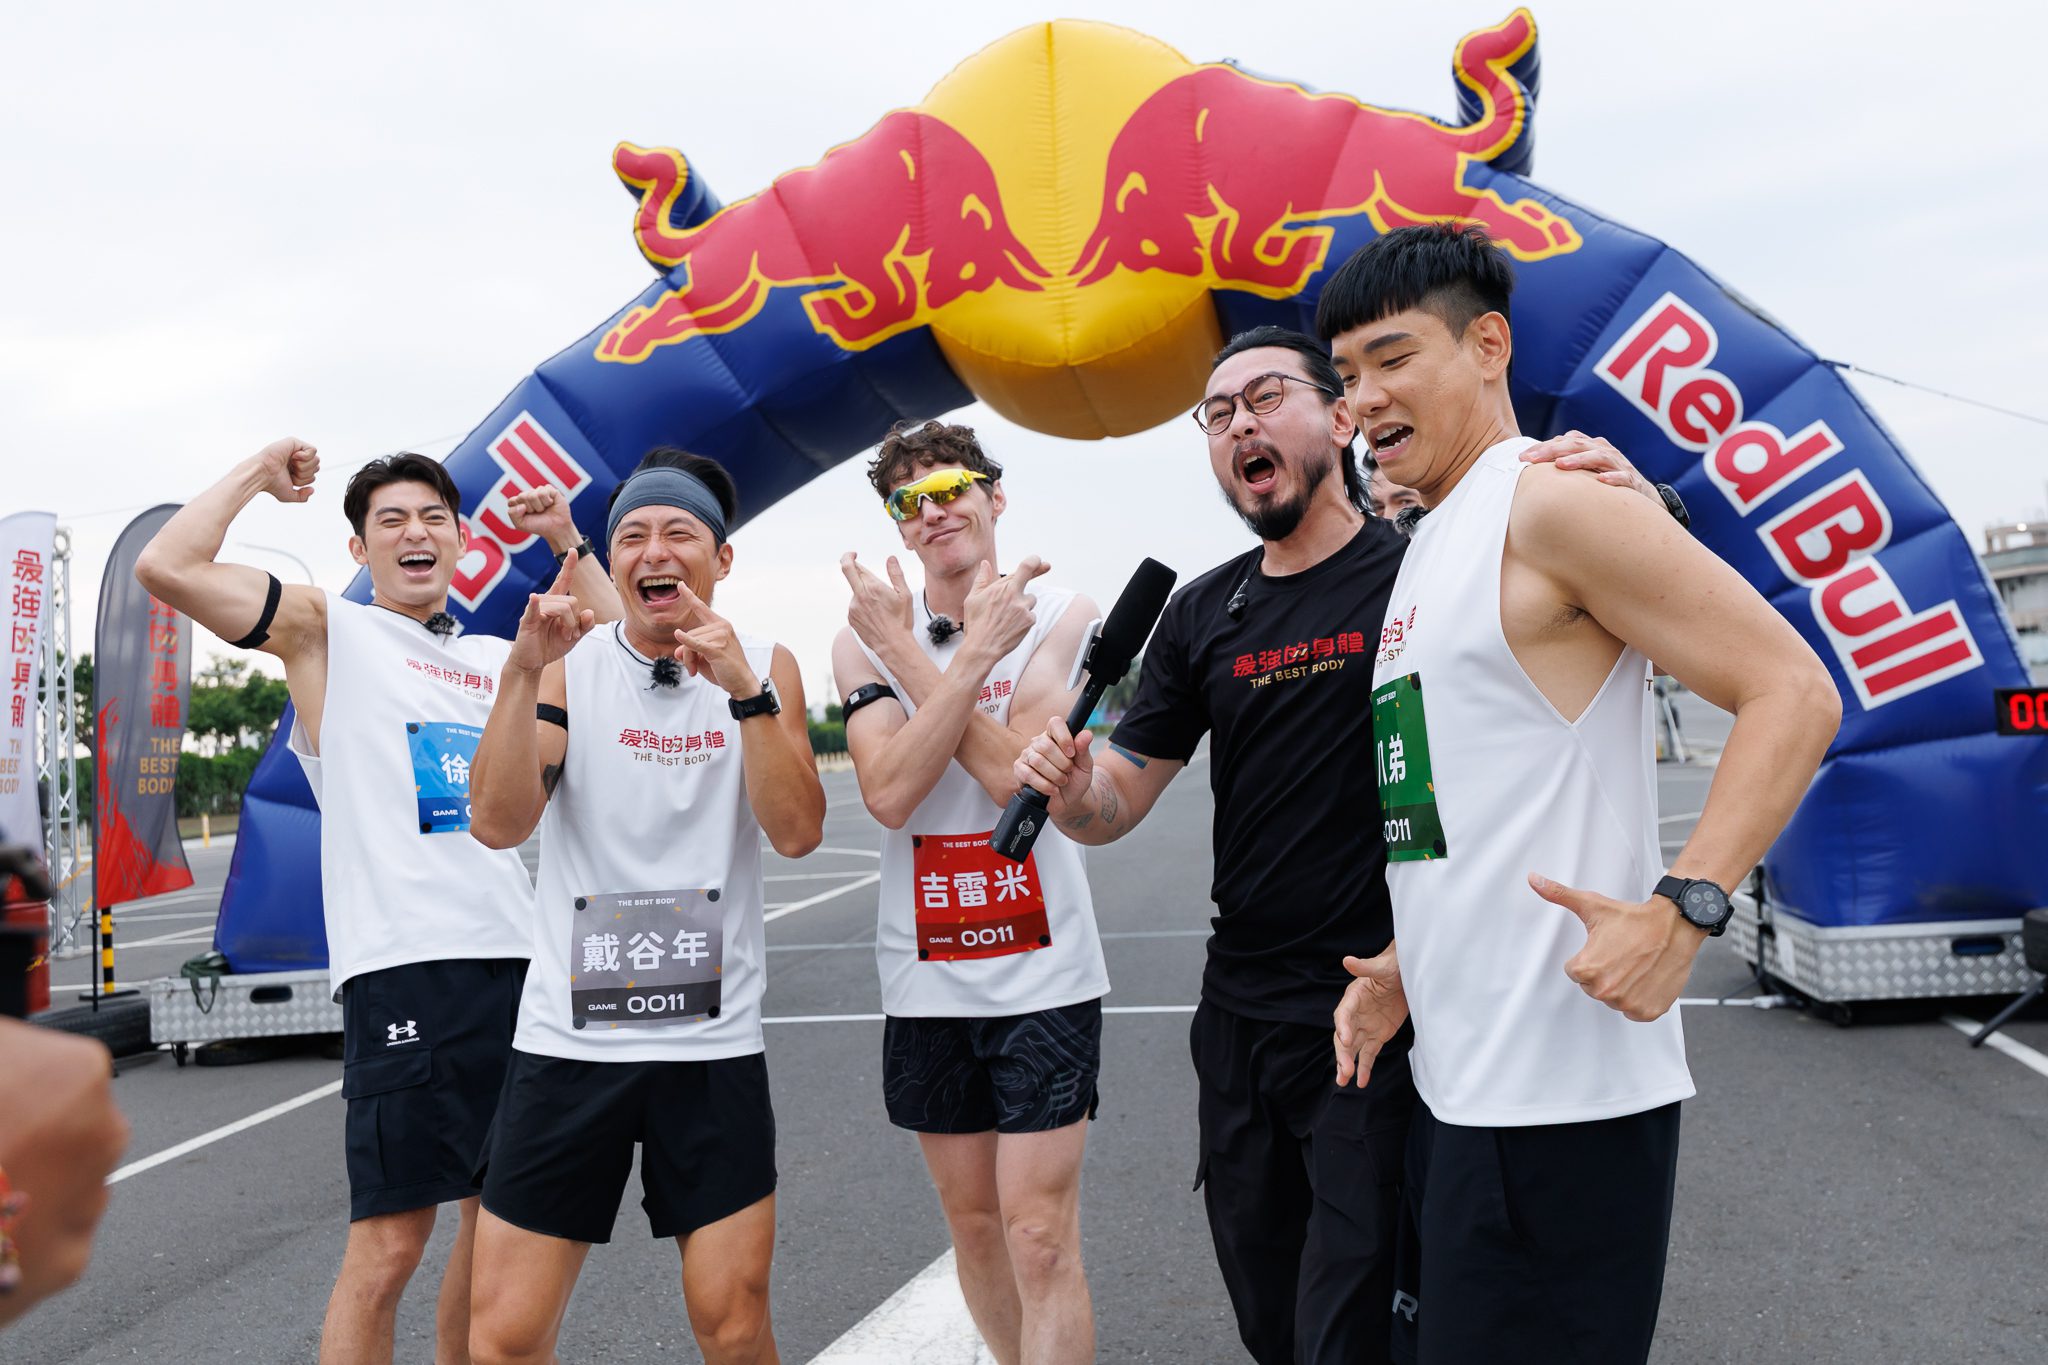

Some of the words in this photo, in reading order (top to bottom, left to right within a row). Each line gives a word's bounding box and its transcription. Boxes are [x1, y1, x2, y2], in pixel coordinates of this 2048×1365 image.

[1606, 302, 1834, 506] Red
[1768, 479, 1974, 699] Bull
[149, 594, 181, 729] 的身體
[1232, 631, 1365, 677] 最強的身體
[1249, 674, 1272, 689] THE
[1275, 666, 1308, 681] BEST
[1311, 659, 1346, 674] BODY
[983, 703, 1001, 715] ODY
[150, 737, 181, 754] THE
[618, 728, 727, 754] 最強的身體
[140, 757, 178, 774] BEST
[633, 751, 653, 762] THE
[656, 754, 681, 766] BEST
[684, 752, 713, 766] BODY
[138, 777, 176, 795] BODY
[432, 808, 459, 817] GAME
[1384, 818, 1412, 842] 0011
[920, 864, 1031, 909] 吉雷米
[634, 898, 654, 906] BEST
[655, 897, 676, 905] BODY
[929, 936, 954, 944] GAME
[960, 925, 1015, 947] 0011
[582, 929, 711, 973] 戴谷年
[588, 1003, 618, 1011] GAME
[627, 993, 685, 1014] 0011
